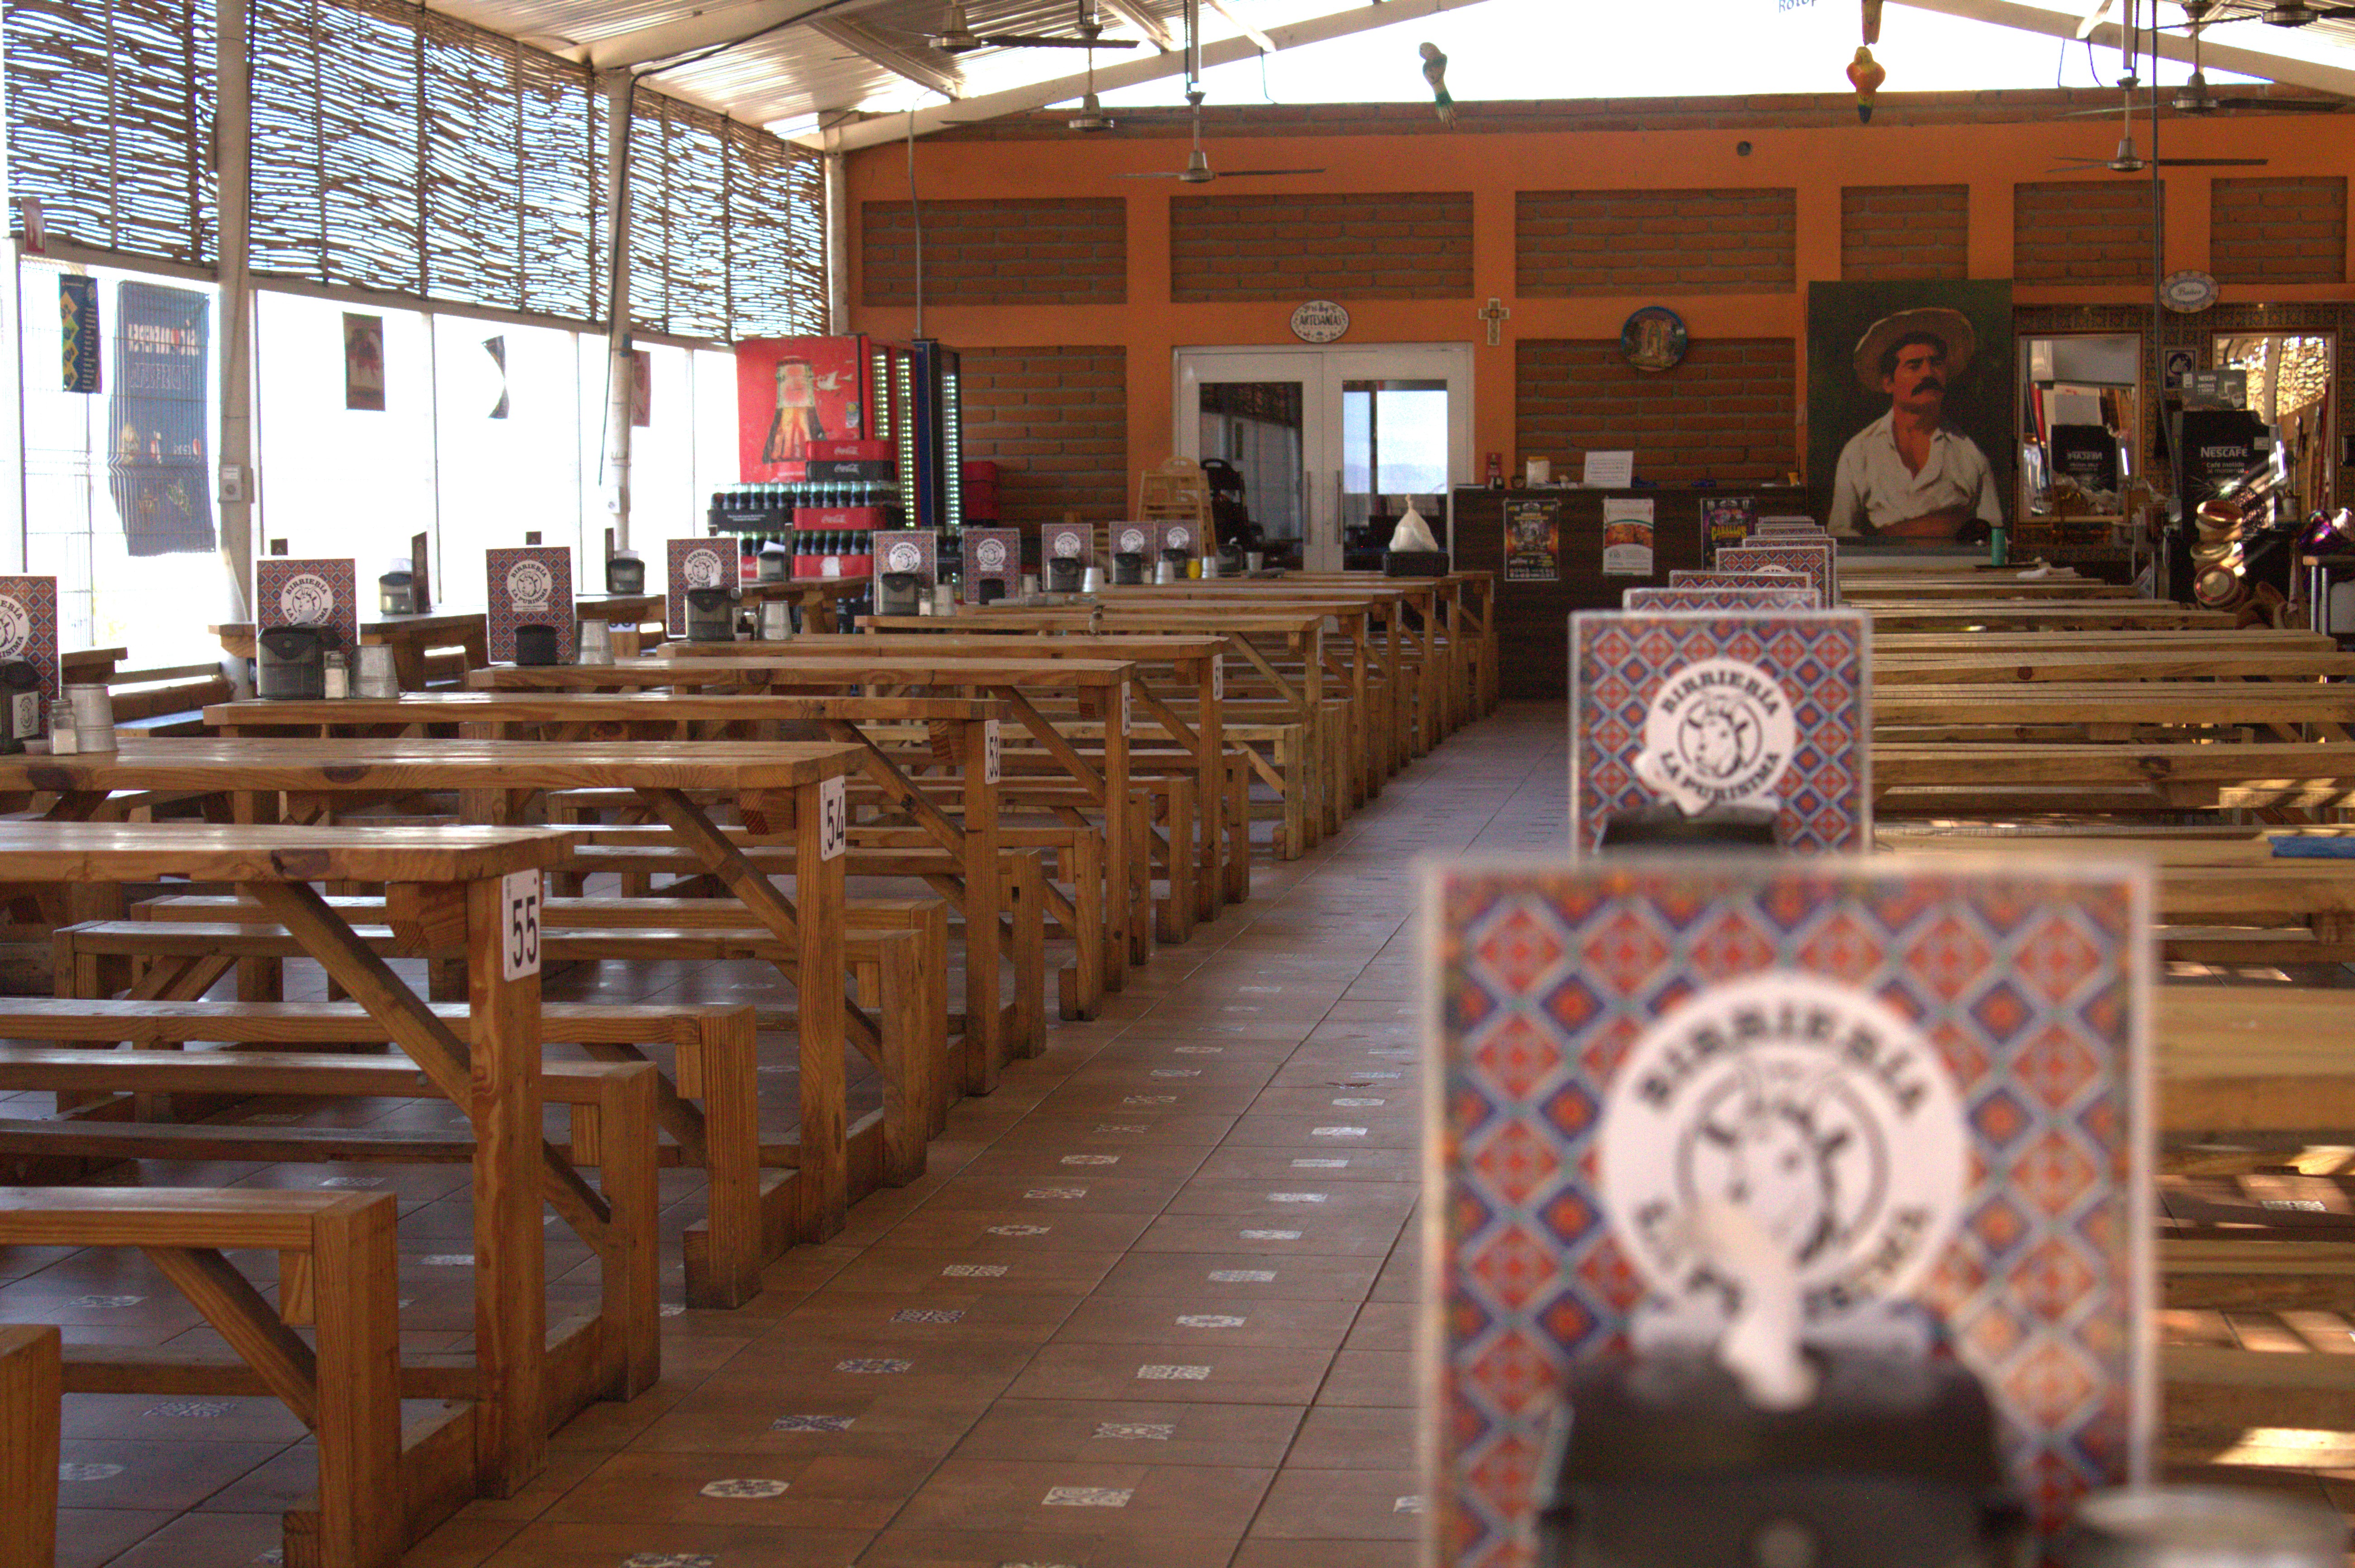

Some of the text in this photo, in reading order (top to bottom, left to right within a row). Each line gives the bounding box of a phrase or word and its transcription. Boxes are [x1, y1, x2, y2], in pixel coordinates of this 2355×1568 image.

[511, 564, 547, 578] BIRRIERÍA
[285, 578, 328, 595] BIRRIERÍA
[512, 588, 518, 598] LA
[286, 607, 294, 618] LA
[990, 736, 999, 778] 53
[1660, 750, 1681, 779] LA
[827, 796, 844, 851] 54
[513, 895, 537, 968] 55
